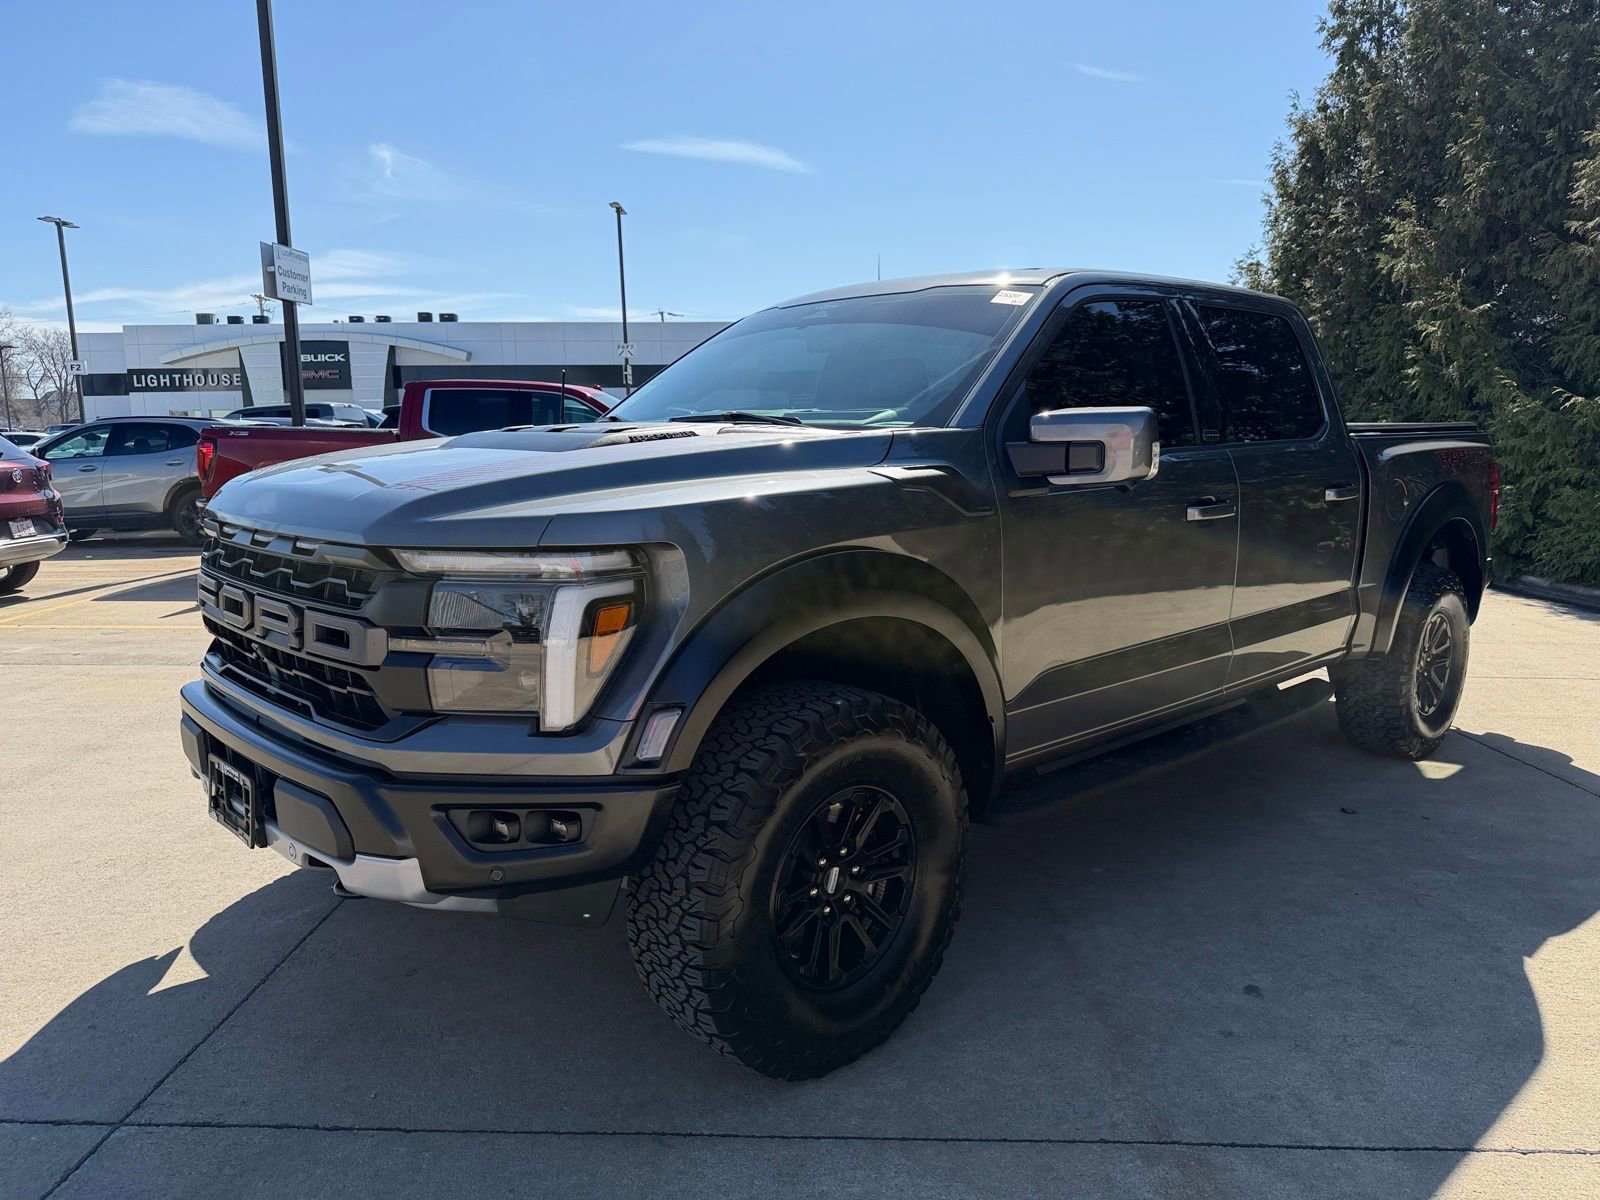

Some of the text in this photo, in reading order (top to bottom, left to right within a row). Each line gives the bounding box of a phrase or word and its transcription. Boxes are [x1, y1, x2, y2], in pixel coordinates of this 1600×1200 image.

[277, 265, 308, 282] Customer
[282, 281, 307, 299] Parking
[300, 353, 346, 362] BUICK
[133, 373, 242, 387] LIGHTHOUSE
[197, 571, 388, 667] FORD
